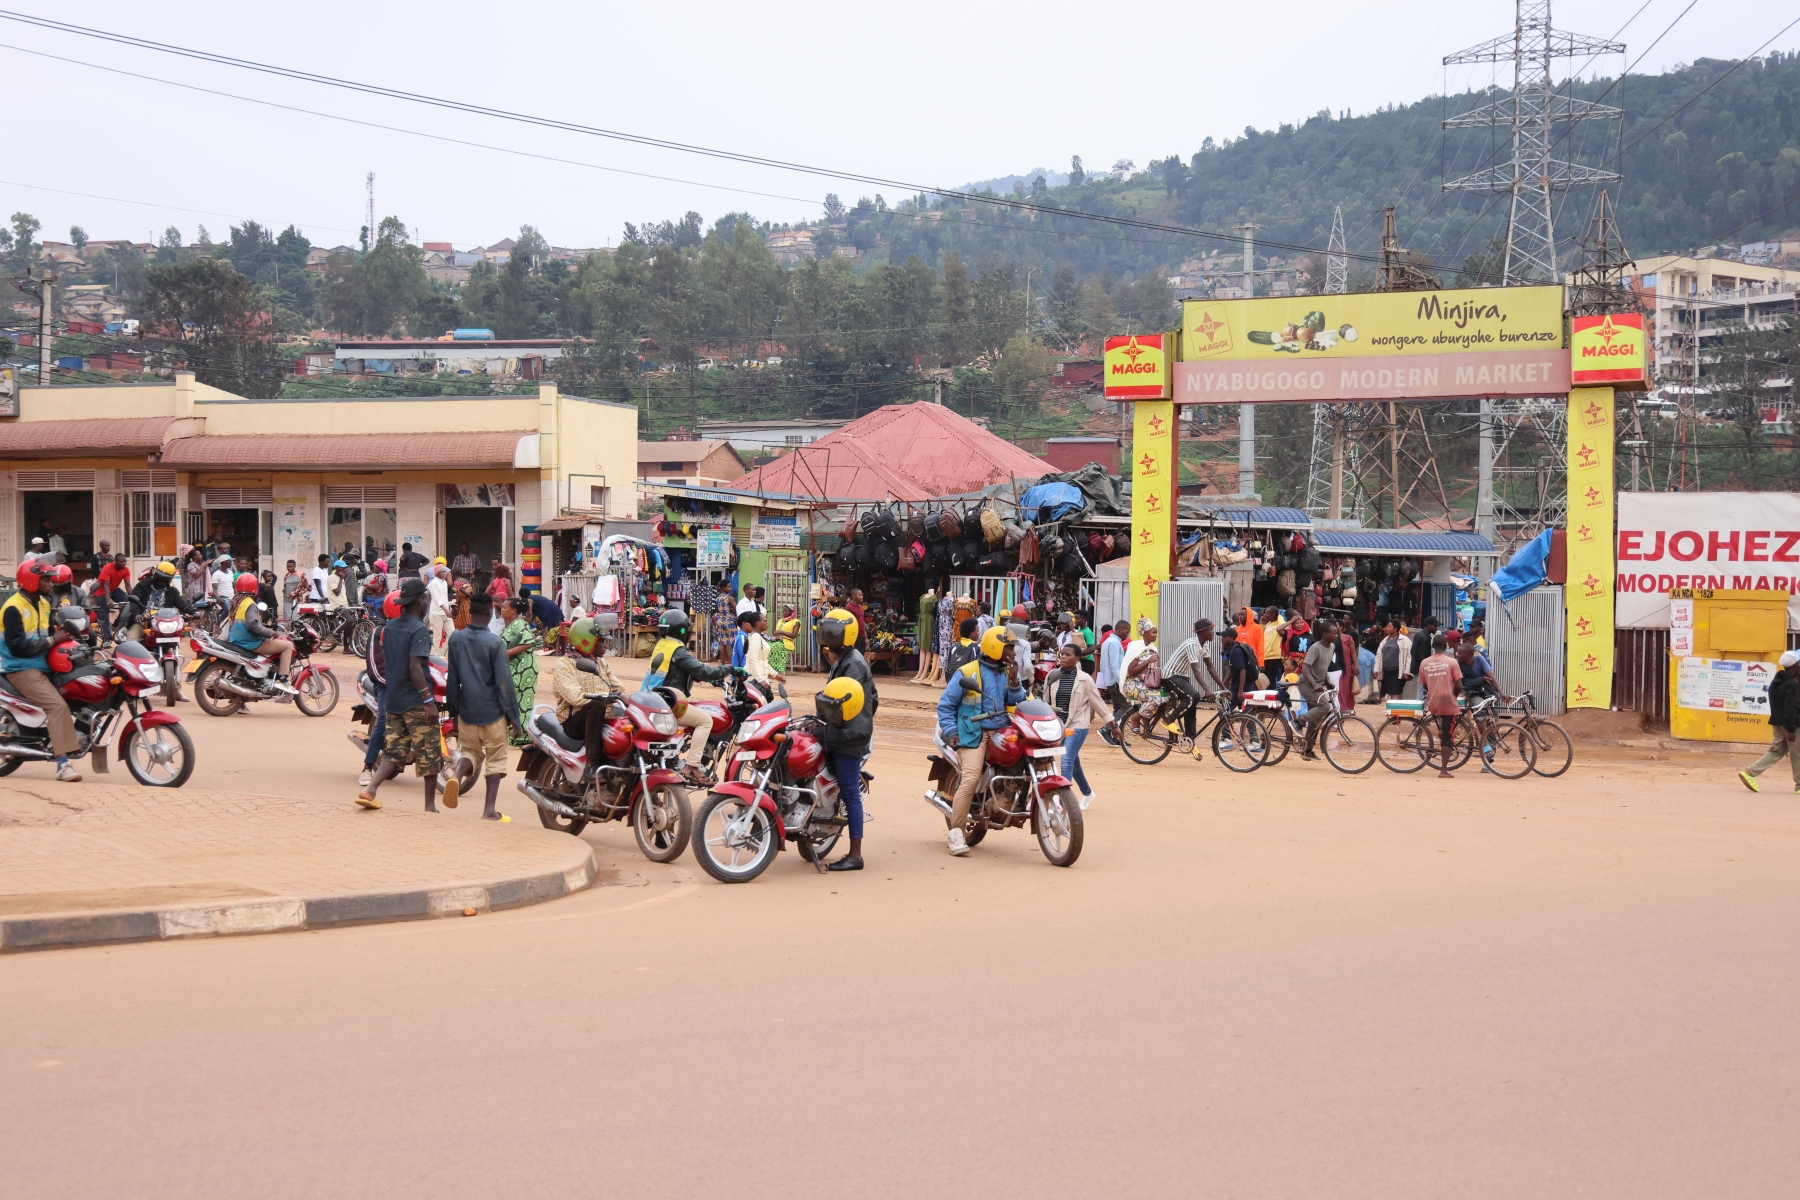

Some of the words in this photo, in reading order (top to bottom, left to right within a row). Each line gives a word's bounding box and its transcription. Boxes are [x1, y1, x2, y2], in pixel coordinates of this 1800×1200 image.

[1417, 294, 1507, 328] Minjira,
[1198, 340, 1228, 353] MAGGI
[1371, 335, 1428, 350] wongere
[1432, 329, 1495, 349] uburyohe
[1499, 329, 1557, 342] burenze
[1582, 344, 1634, 357] MAGGI
[1112, 363, 1156, 375] MAGGI
[1187, 371, 1325, 391] NYABUGOGO
[1340, 368, 1438, 389] MODERN
[1455, 362, 1553, 385] MARKET
[1618, 530, 1800, 562] EJOHEZ
[1616, 573, 1725, 593] MODERN
